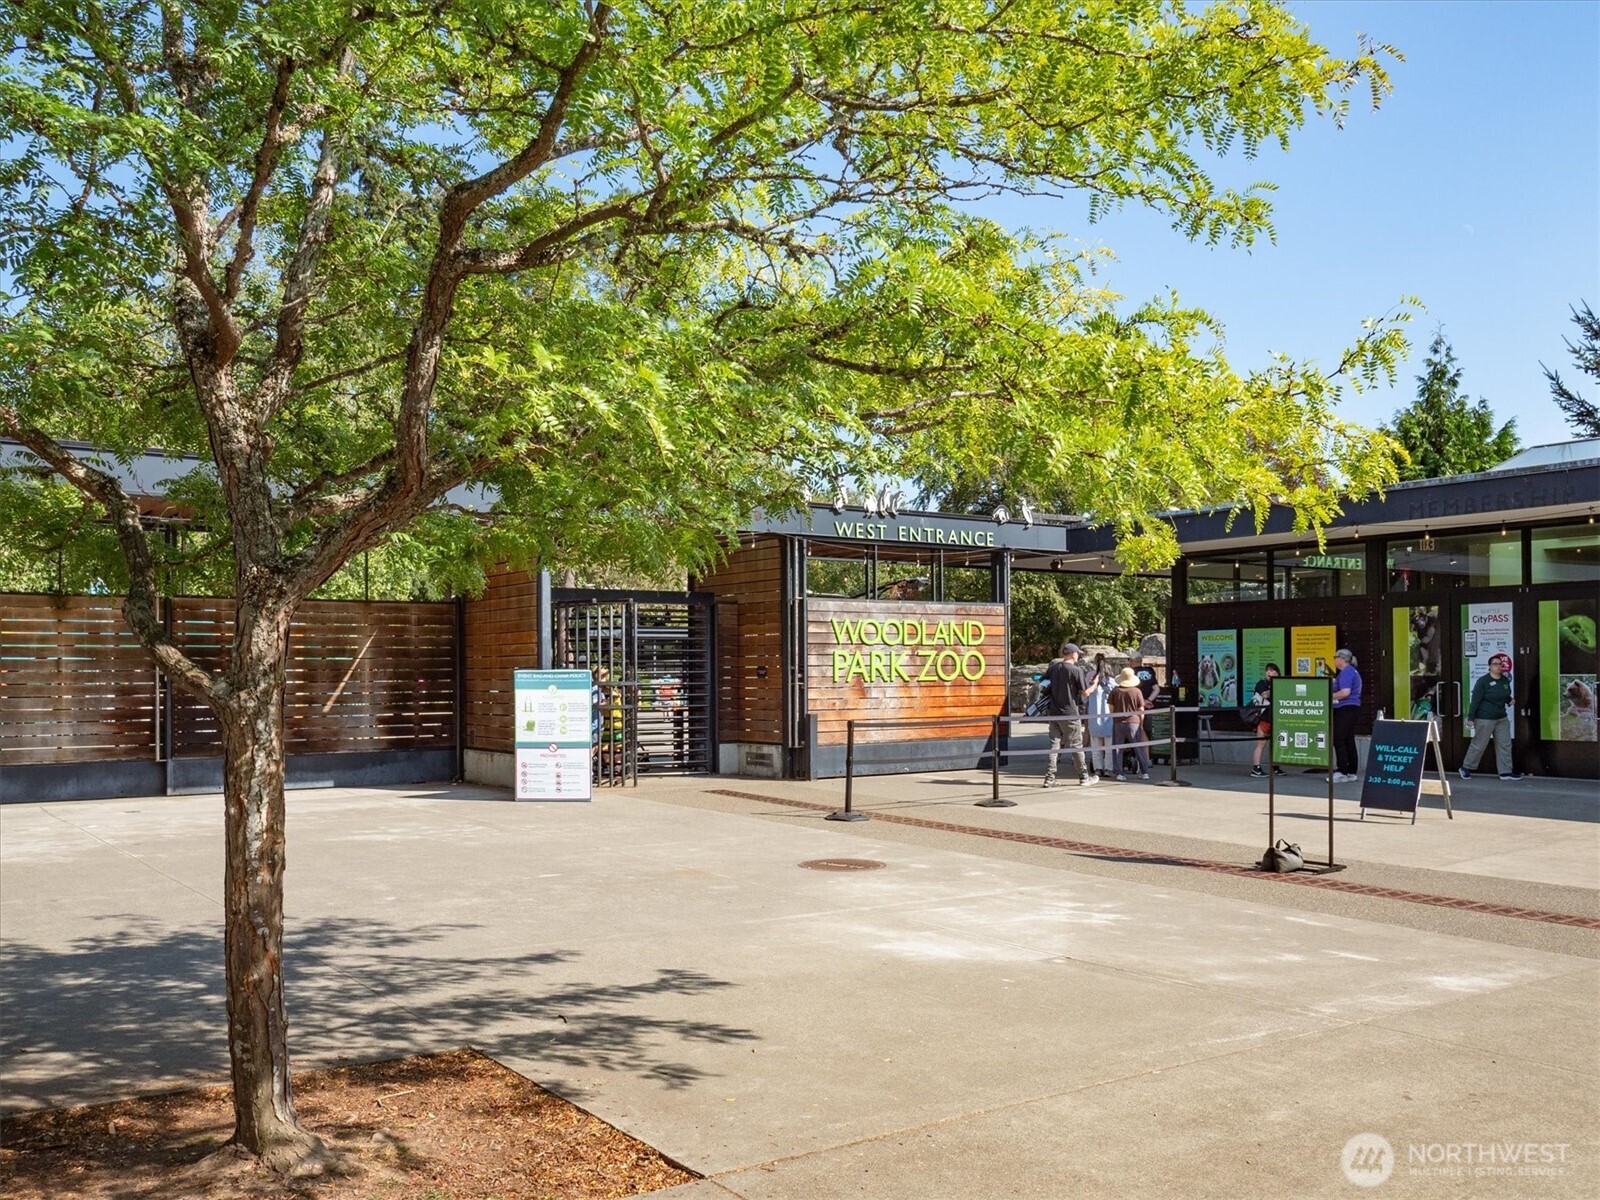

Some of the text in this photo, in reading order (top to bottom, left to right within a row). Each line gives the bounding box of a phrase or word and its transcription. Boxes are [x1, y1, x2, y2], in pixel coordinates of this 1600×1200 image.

[1409, 488, 1576, 519] MEMBERSHIP
[834, 521, 994, 546] WEST ENTRANCE
[1472, 614, 1509, 625] CityPASS
[830, 618, 985, 646] WOODLAND
[1201, 634, 1234, 642] WELCOME
[833, 650, 986, 683] PARK ZOO
[1375, 744, 1419, 754] WILL-CALL
[1384, 754, 1414, 763] TICKET
[1383, 764, 1405, 772] HELP
